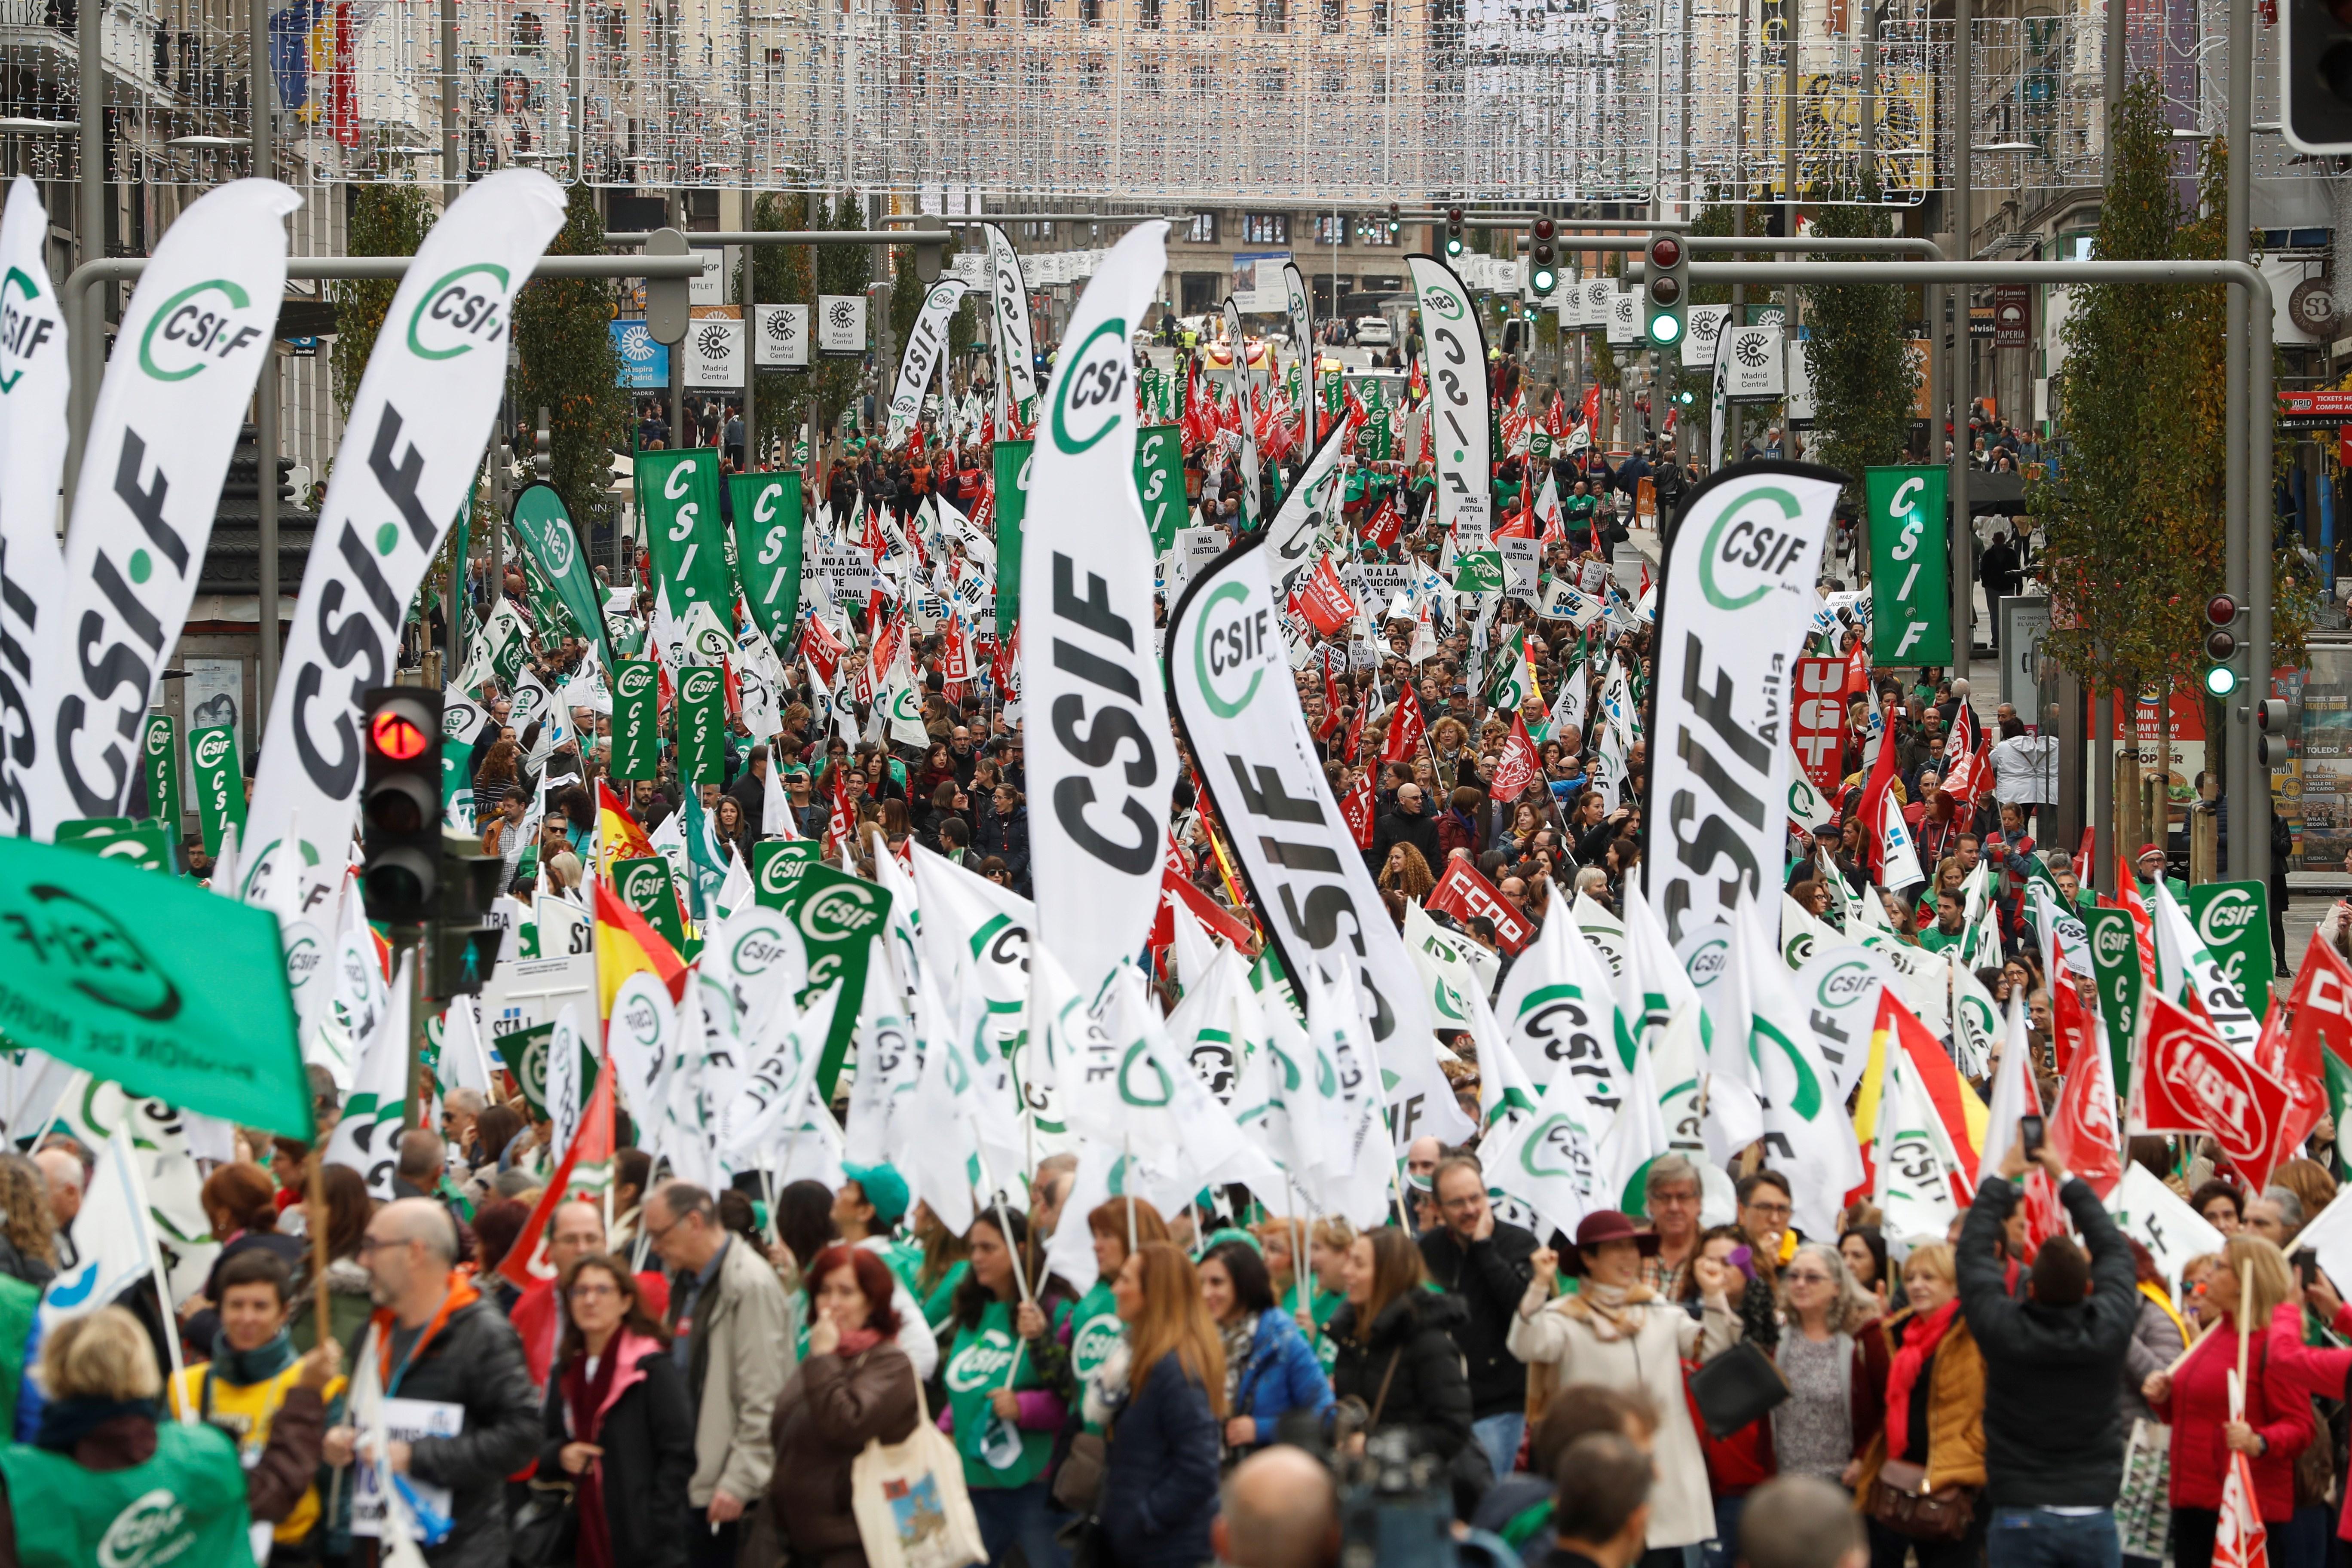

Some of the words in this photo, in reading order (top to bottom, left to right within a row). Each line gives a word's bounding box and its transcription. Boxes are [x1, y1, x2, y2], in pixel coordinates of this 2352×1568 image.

[1997, 329, 2025, 339] TAPERÍA
[904, 318, 939, 389] CSIF
[1362, 433, 1376, 441] CSIF
[1534, 441, 1550, 449] CSIF
[1197, 535, 1212, 544] MÁS
[1512, 542, 1527, 550] MÁS
[1722, 521, 1808, 576] CSIF
[1191, 546, 1220, 554] JUSTICIA
[1504, 552, 1534, 561] JUSTICIA
[821, 557, 835, 566] NO
[838, 558, 845, 566] A
[849, 557, 861, 566] LA
[1890, 477, 1929, 657] CSIF
[1386, 568, 1399, 576] LA
[958, 578, 984, 605] STAJ
[1351, 578, 1406, 587] RDUCCIÓN
[1582, 579, 1601, 588] DESTINO
[1210, 609, 1268, 677] CSIF
[1313, 654, 1340, 672] FORSA!
[1314, 648, 1344, 667] MOVLIDAD
[1335, 650, 1343, 658] LA
[624, 674, 653, 687] CSIF
[689, 680, 719, 692] CSIF
[1751, 652, 1784, 747] Ávila
[1051, 550, 1159, 876] CSIF
[1797, 662, 1845, 766] UGT
[2136, 709, 2157, 720] MIN.
[2170, 723, 2180, 732] 69
[152, 731, 171, 744] CSIF
[625, 701, 643, 774] CSIF
[692, 707, 709, 779] CSIF
[202, 740, 231, 756] CSIF
[157, 760, 170, 830] CSI
[631, 876, 665, 897] CSIF
[816, 897, 878, 928] CSIF
[1448, 870, 1524, 941] CCOO
[2210, 905, 2259, 927] CSIF
[742, 941, 787, 962] CSIF
[2101, 932, 2131, 952] CSIF
[288, 953, 321, 972] CSIF
[1829, 975, 1879, 995] CSIF
[968, 1348, 1014, 1375] CSIF
